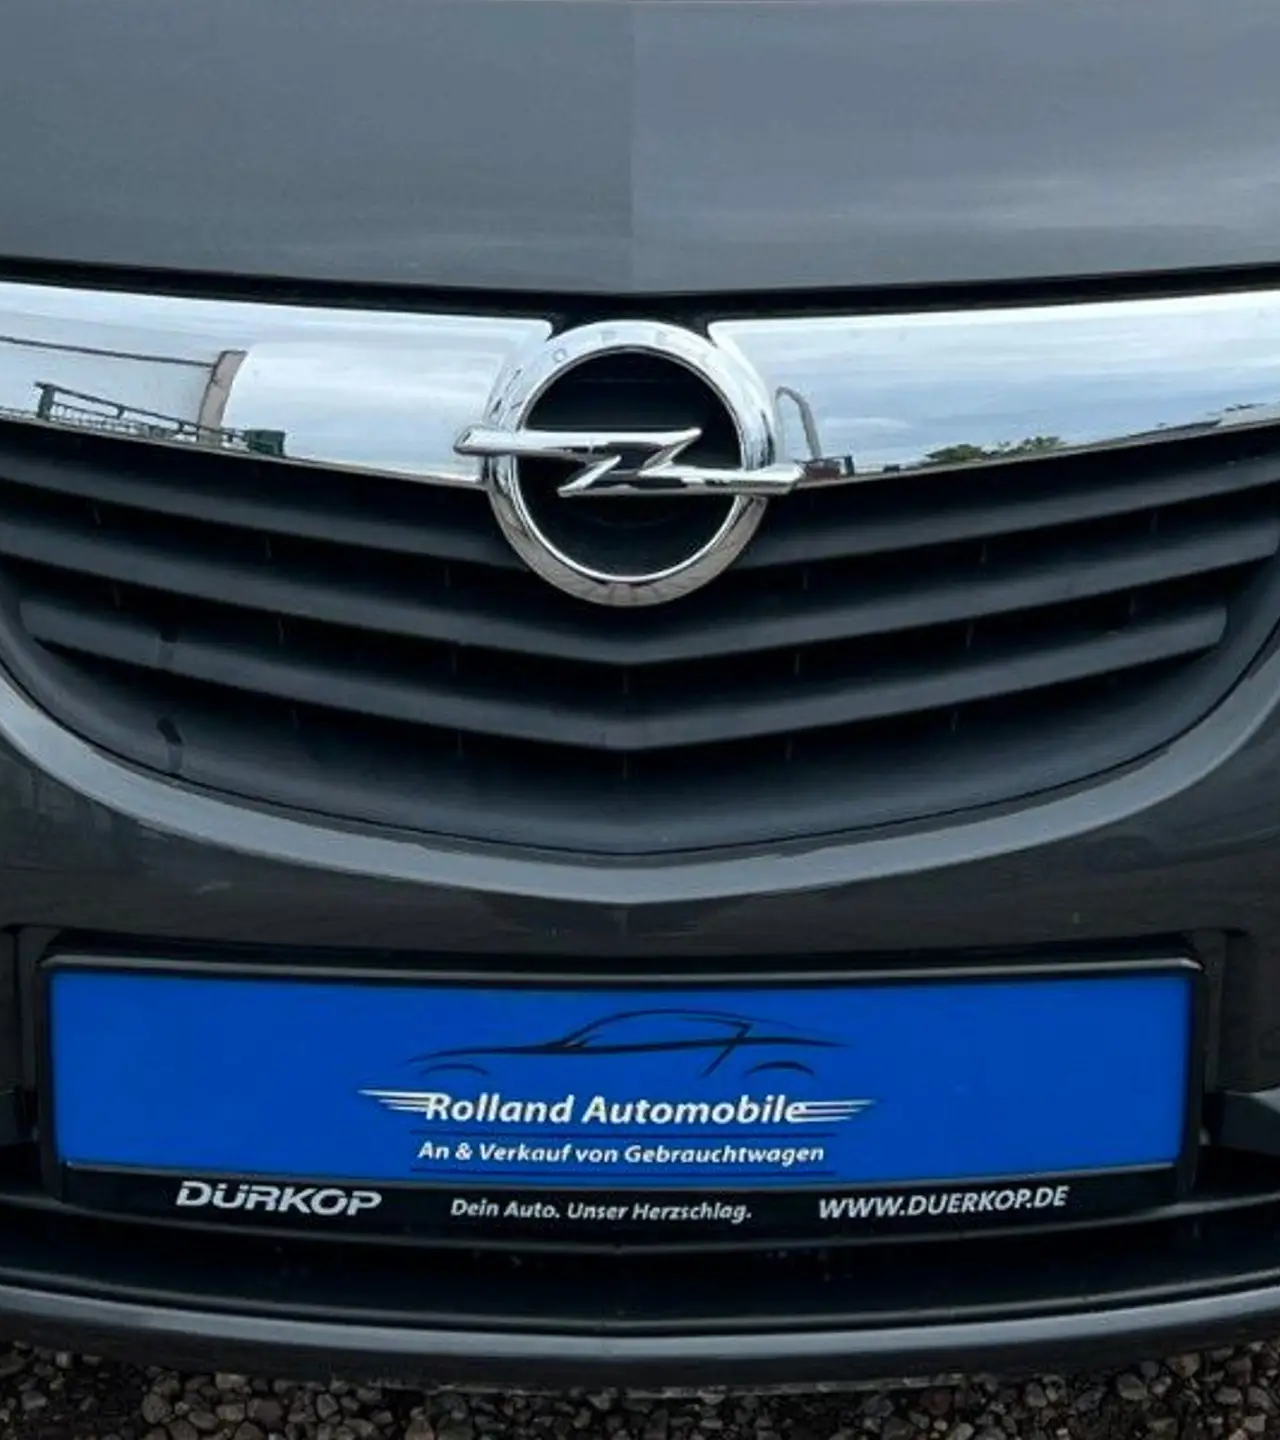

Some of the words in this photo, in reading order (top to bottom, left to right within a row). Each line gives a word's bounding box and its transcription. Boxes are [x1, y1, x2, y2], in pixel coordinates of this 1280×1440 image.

[425, 1093, 575, 1124] Rolland
[582, 1094, 808, 1124] Automobile
[419, 1141, 449, 1160] An
[455, 1143, 473, 1161] &
[480, 1142, 573, 1162] Verkauf
[575, 1147, 618, 1162] von
[624, 1144, 824, 1167] Gebrauchtwagen
[450, 1200, 499, 1218] Dein
[504, 1200, 561, 1219] Auto.
[567, 1201, 628, 1220] Unser
[631, 1201, 753, 1223] Herzschlag.
[819, 1185, 1070, 1219] WWW.DUERKOP.DE
